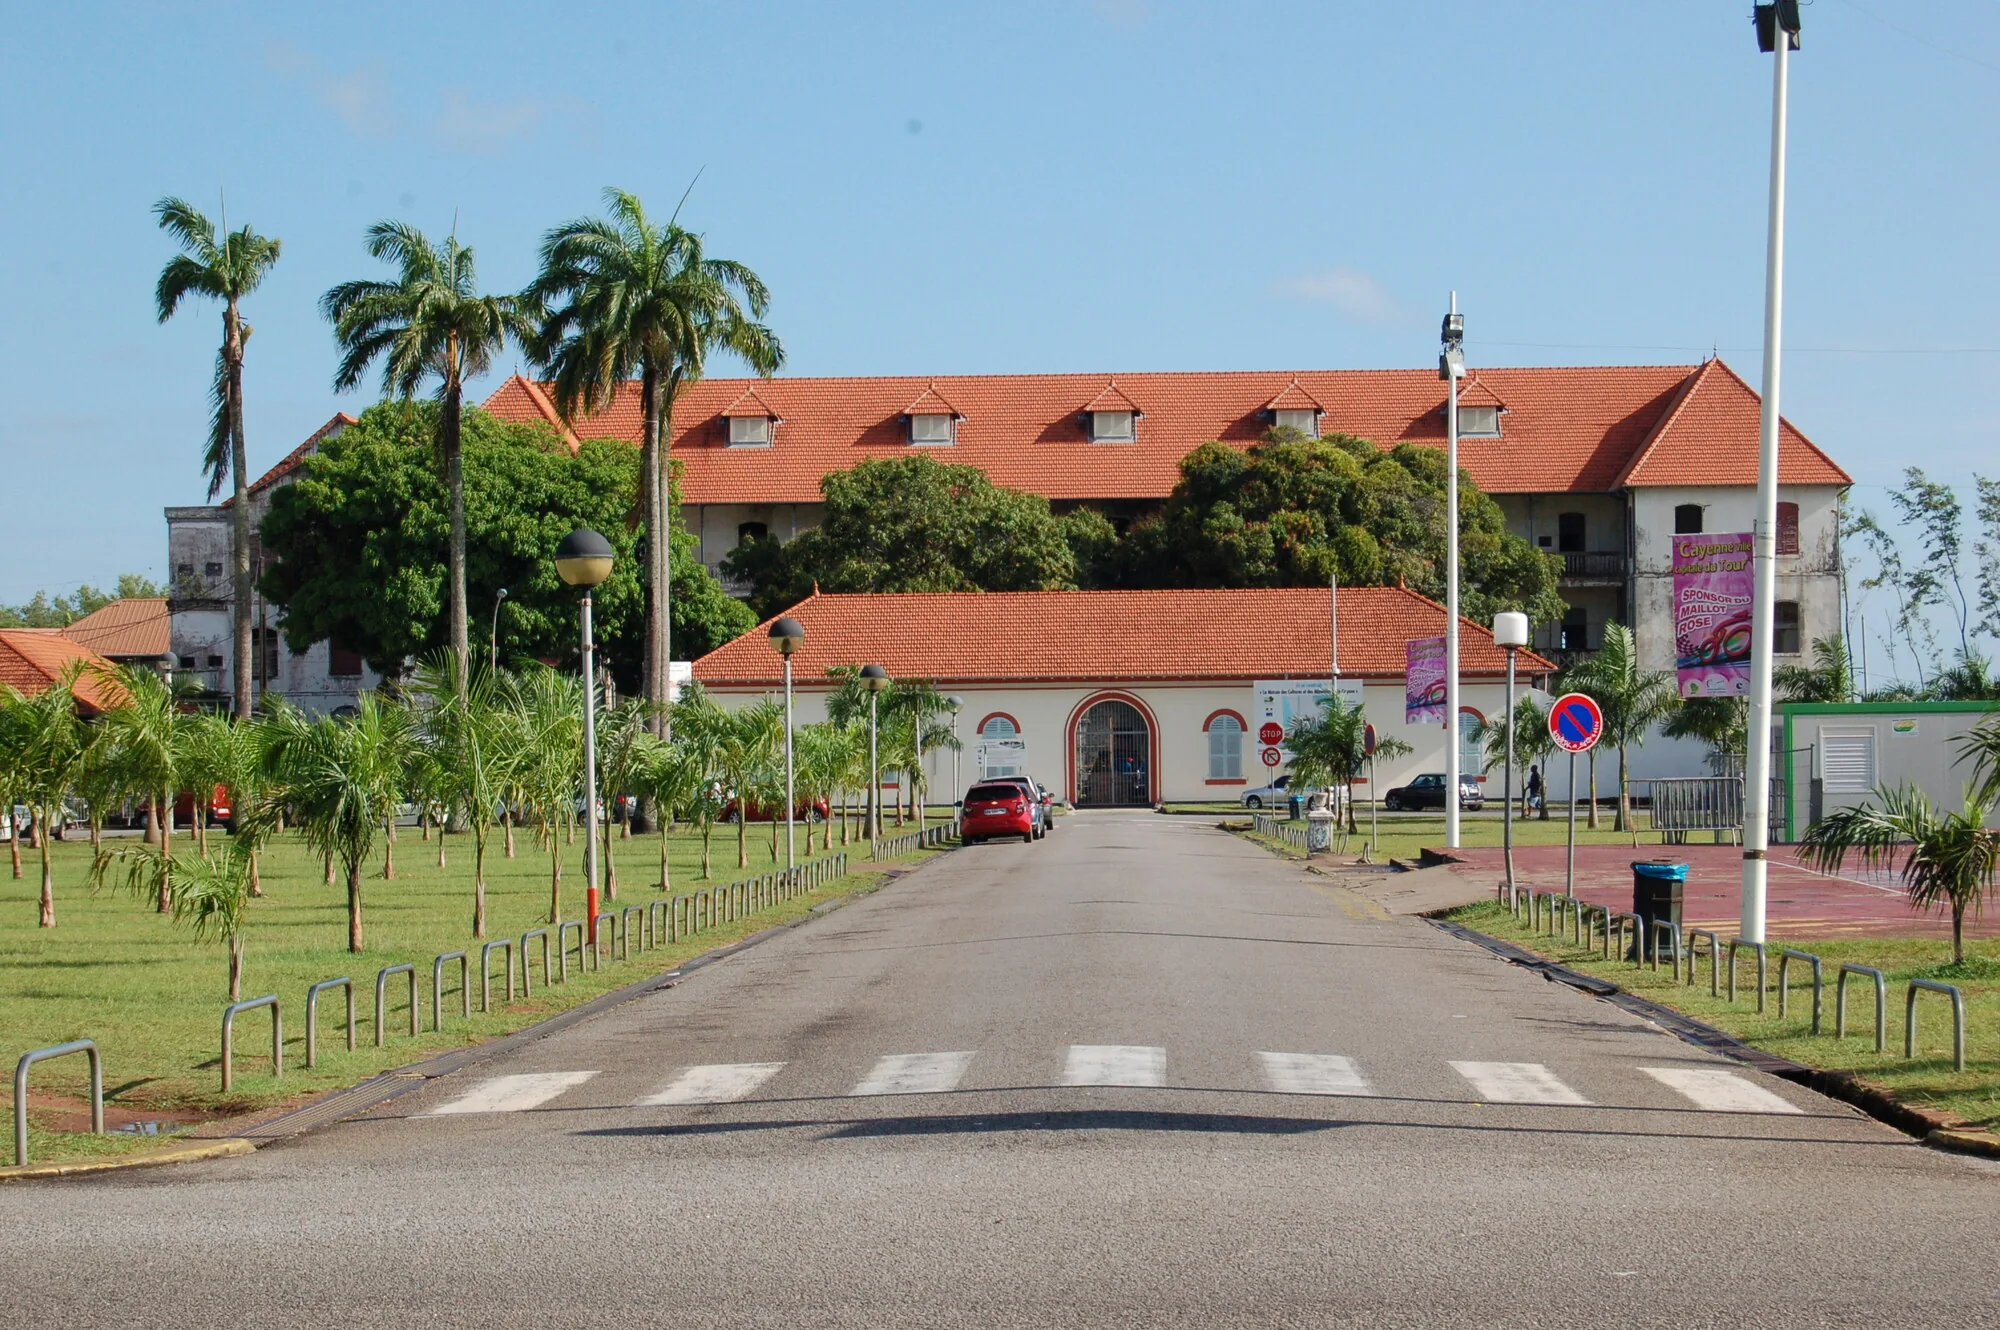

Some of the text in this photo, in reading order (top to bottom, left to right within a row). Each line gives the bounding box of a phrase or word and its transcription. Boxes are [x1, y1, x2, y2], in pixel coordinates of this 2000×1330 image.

[1680, 543, 1733, 560] Cayenne
[1719, 560, 1746, 572] Tour
[1683, 589, 1732, 604] SPONSOR
[1680, 604, 1726, 618] MAILLOT
[1678, 617, 1711, 635] ROSE
[1261, 730, 1281, 738] STOP
